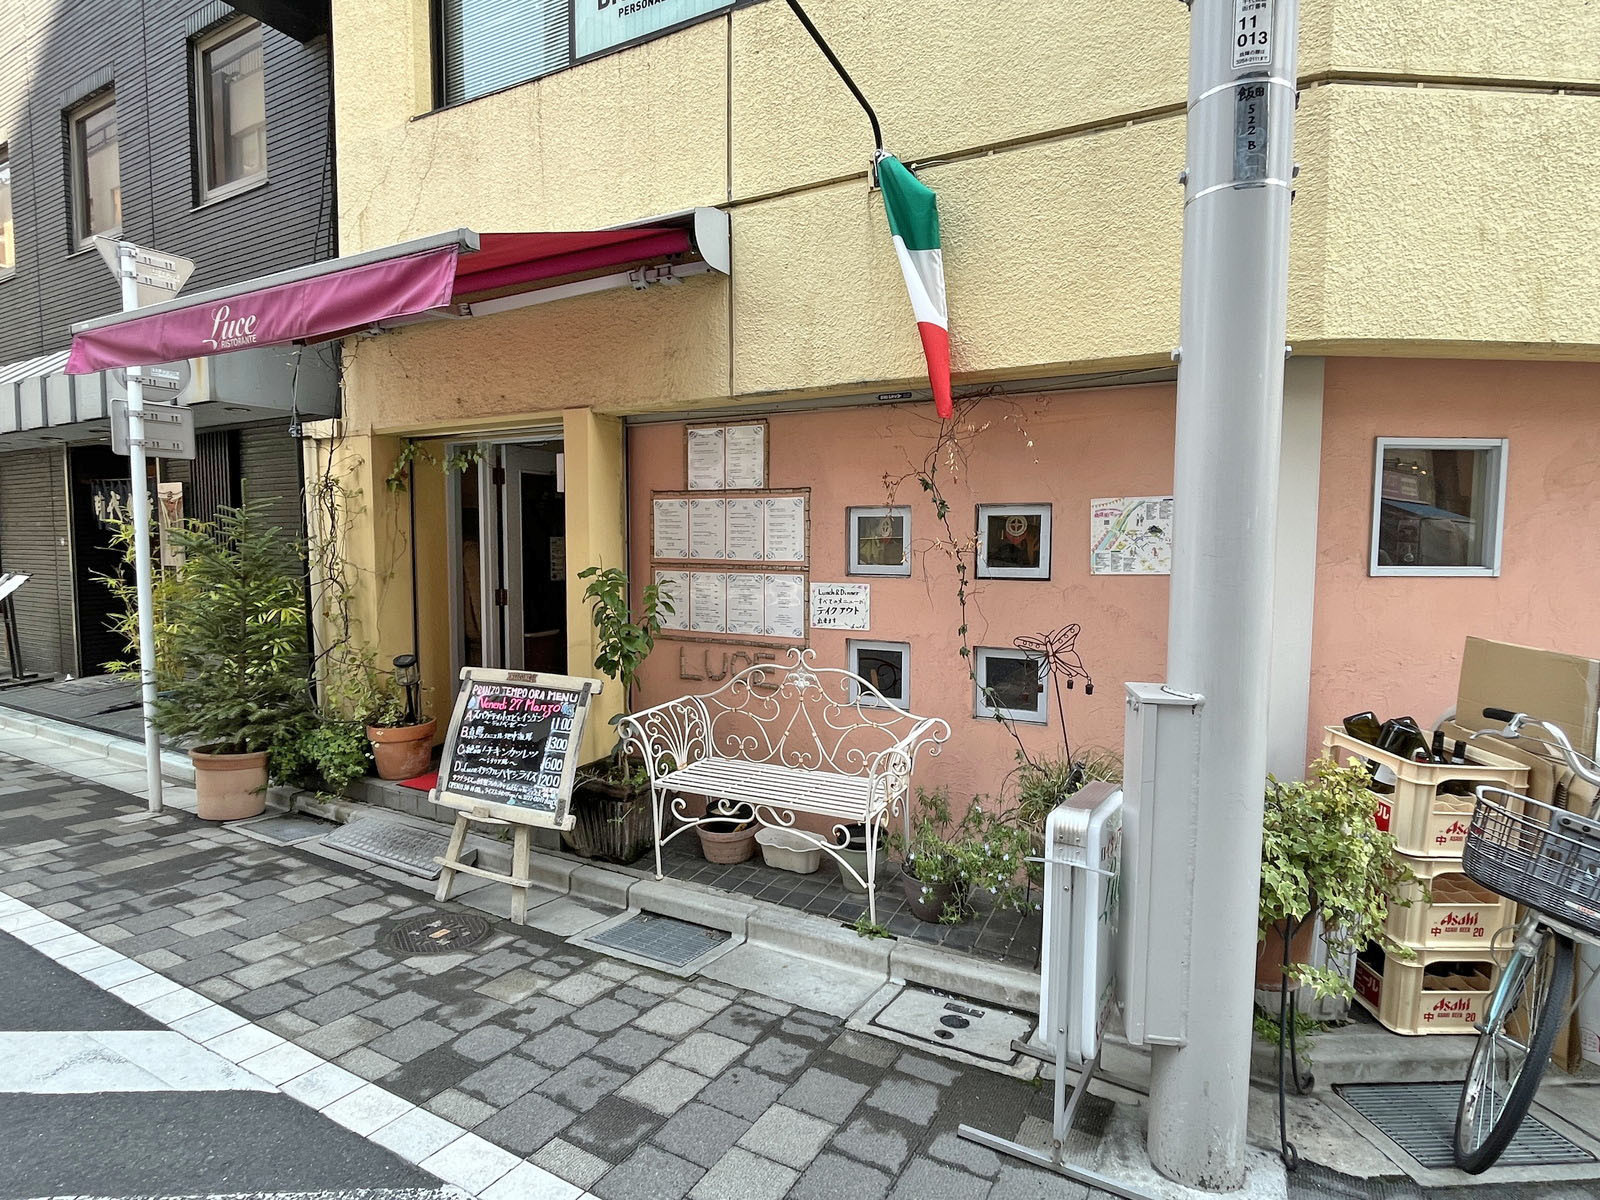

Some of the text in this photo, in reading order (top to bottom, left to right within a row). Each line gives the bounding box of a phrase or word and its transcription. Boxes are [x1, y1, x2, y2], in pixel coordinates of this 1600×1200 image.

[1239, 15, 1257, 30] 11
[1237, 31, 1268, 47] 013
[202, 305, 260, 350] Luce
[221, 334, 257, 348] RISTORANTE
[679, 646, 780, 690] LUCE
[501, 686, 528, 699] TEMPO
[528, 688, 545, 700] ORA
[546, 690, 578, 702] MENU
[509, 699, 522, 711] 27
[525, 699, 561, 718] Marzo
[537, 773, 560, 787] 1200
[1435, 835, 1447, 846] 中
[1440, 911, 1479, 926] Asahi
[1430, 926, 1442, 937] 中
[1472, 927, 1484, 937] 20
[1433, 997, 1471, 1011] Asahi
[1423, 1012, 1435, 1022] 中
[1465, 1012, 1476, 1022] 20
